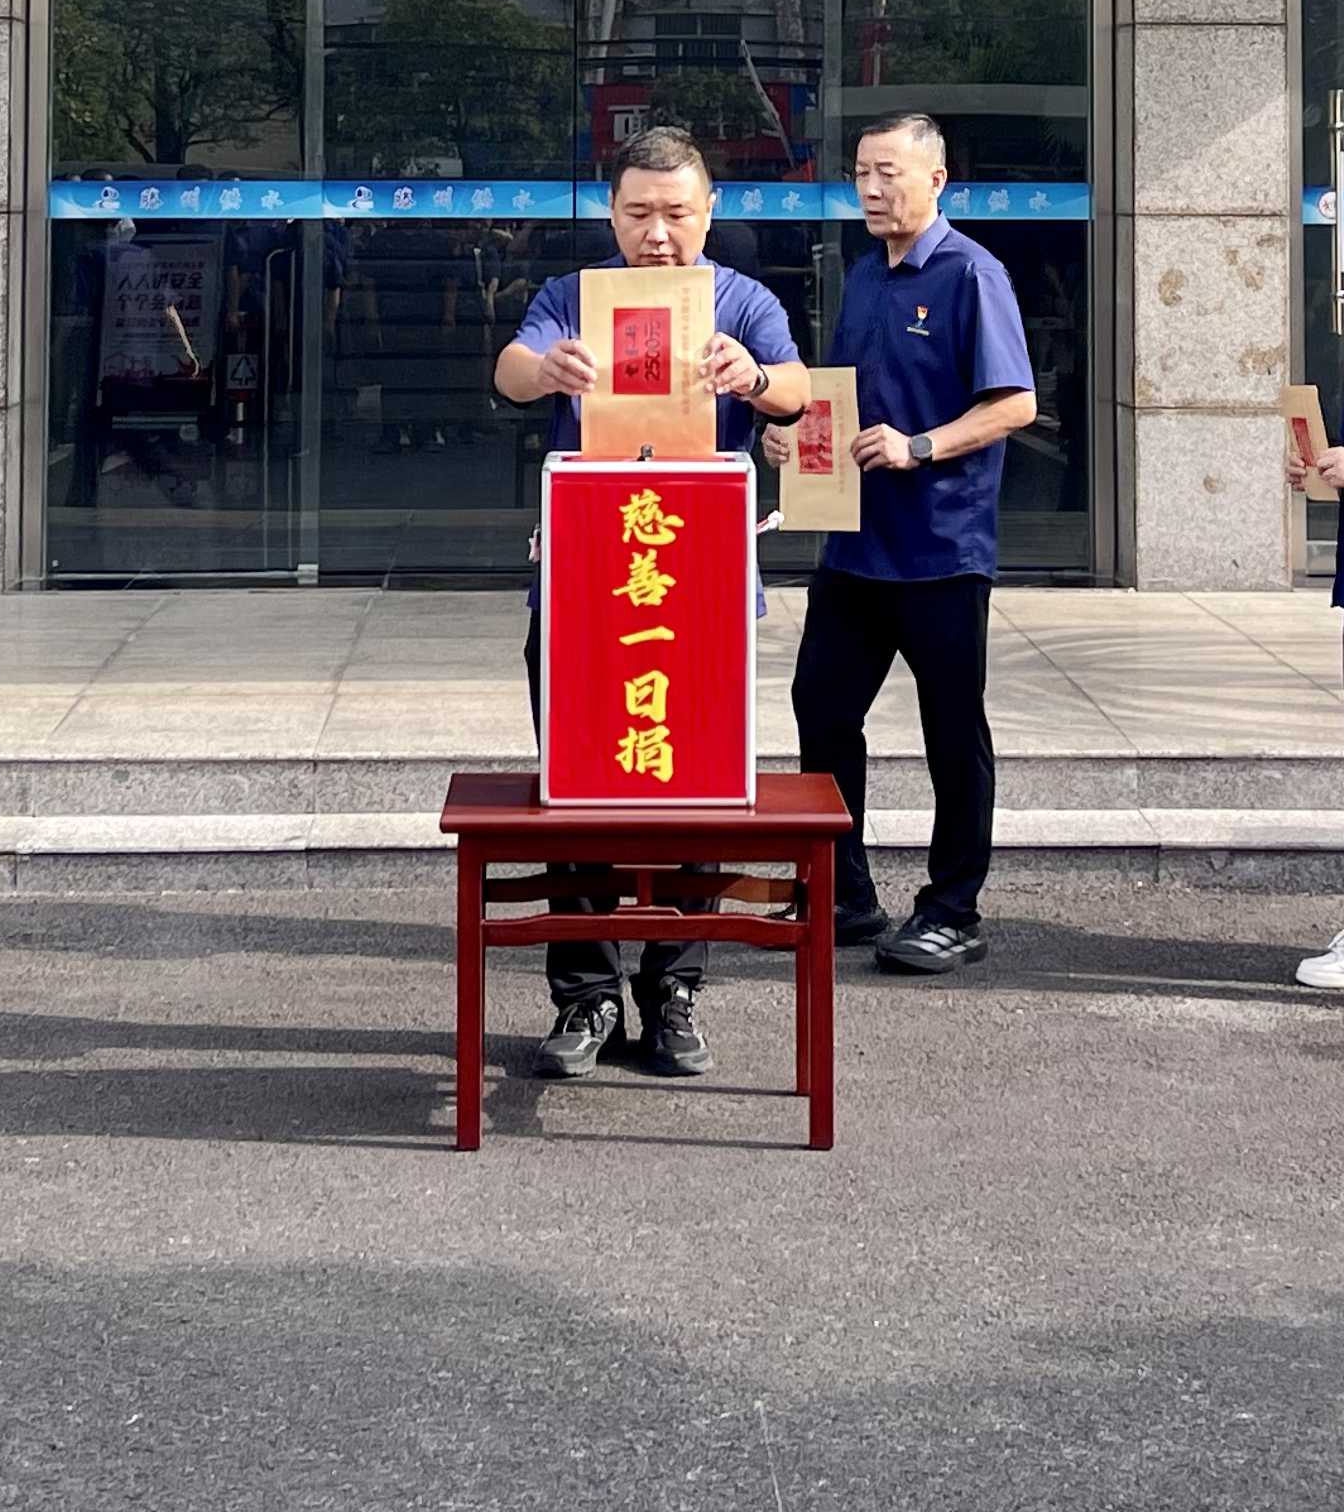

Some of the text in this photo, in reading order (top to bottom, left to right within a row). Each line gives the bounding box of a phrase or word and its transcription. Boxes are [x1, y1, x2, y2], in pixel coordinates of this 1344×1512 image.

[612, 488, 685, 783] 慈善一日捐
